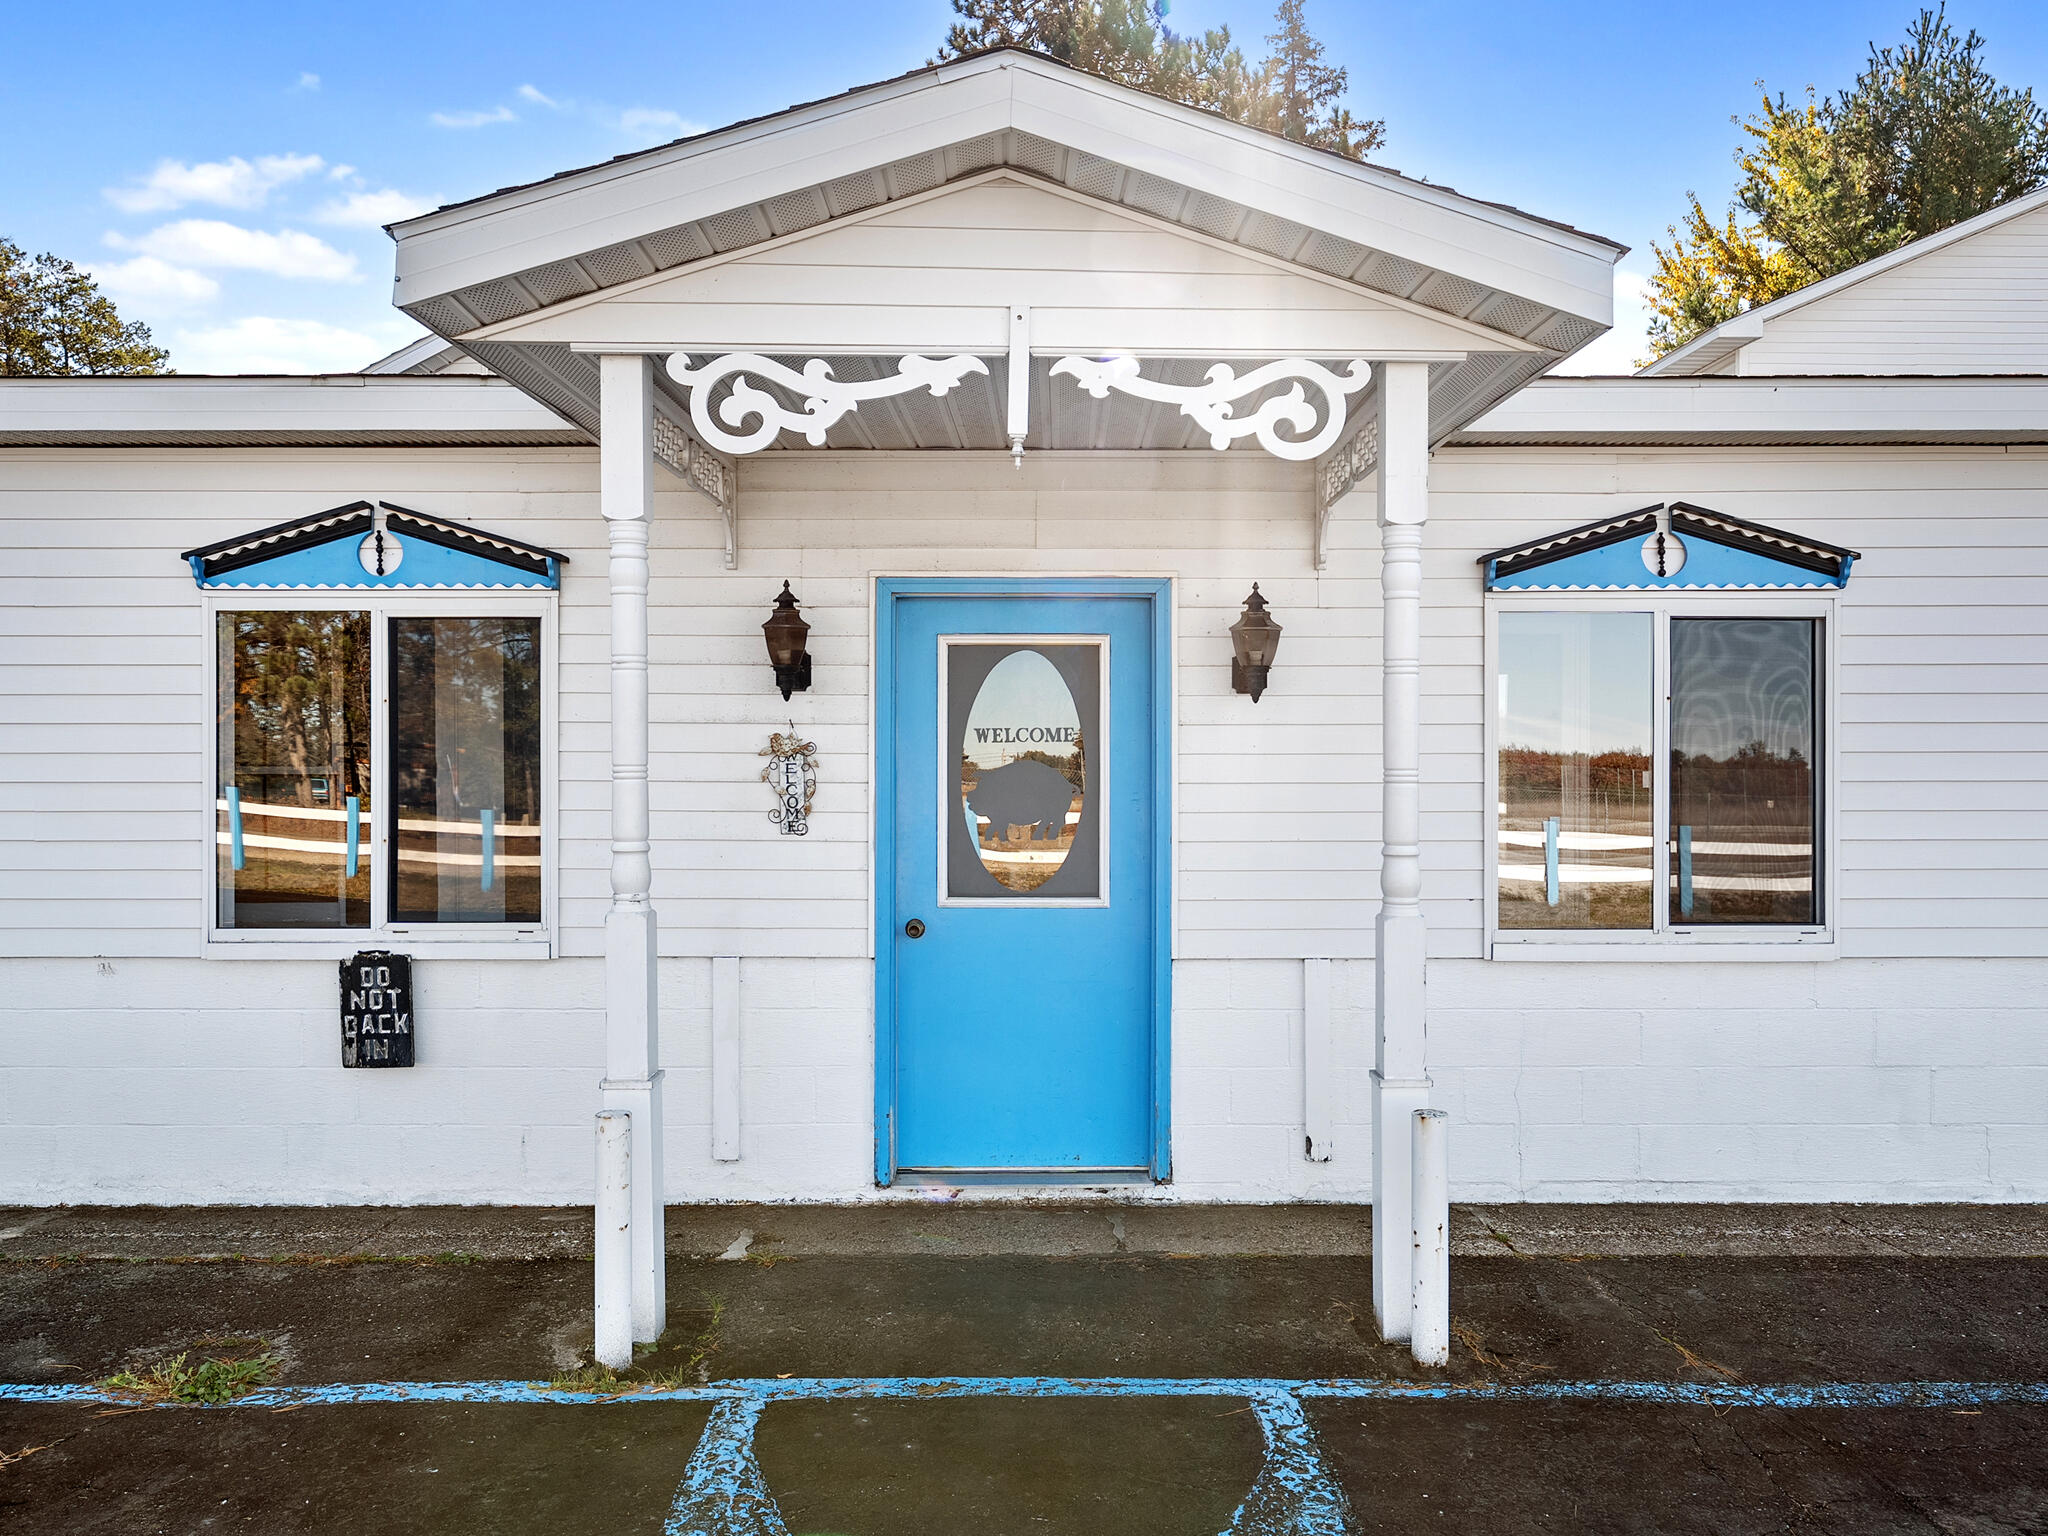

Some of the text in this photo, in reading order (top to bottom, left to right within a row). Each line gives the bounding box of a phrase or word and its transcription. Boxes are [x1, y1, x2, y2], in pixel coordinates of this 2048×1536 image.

[973, 727, 1075, 743] WELCOME
[360, 966, 390, 987] DO
[350, 989, 401, 1010] NOT
[344, 1013, 408, 1038] BACK
[364, 1039, 389, 1060] IN
